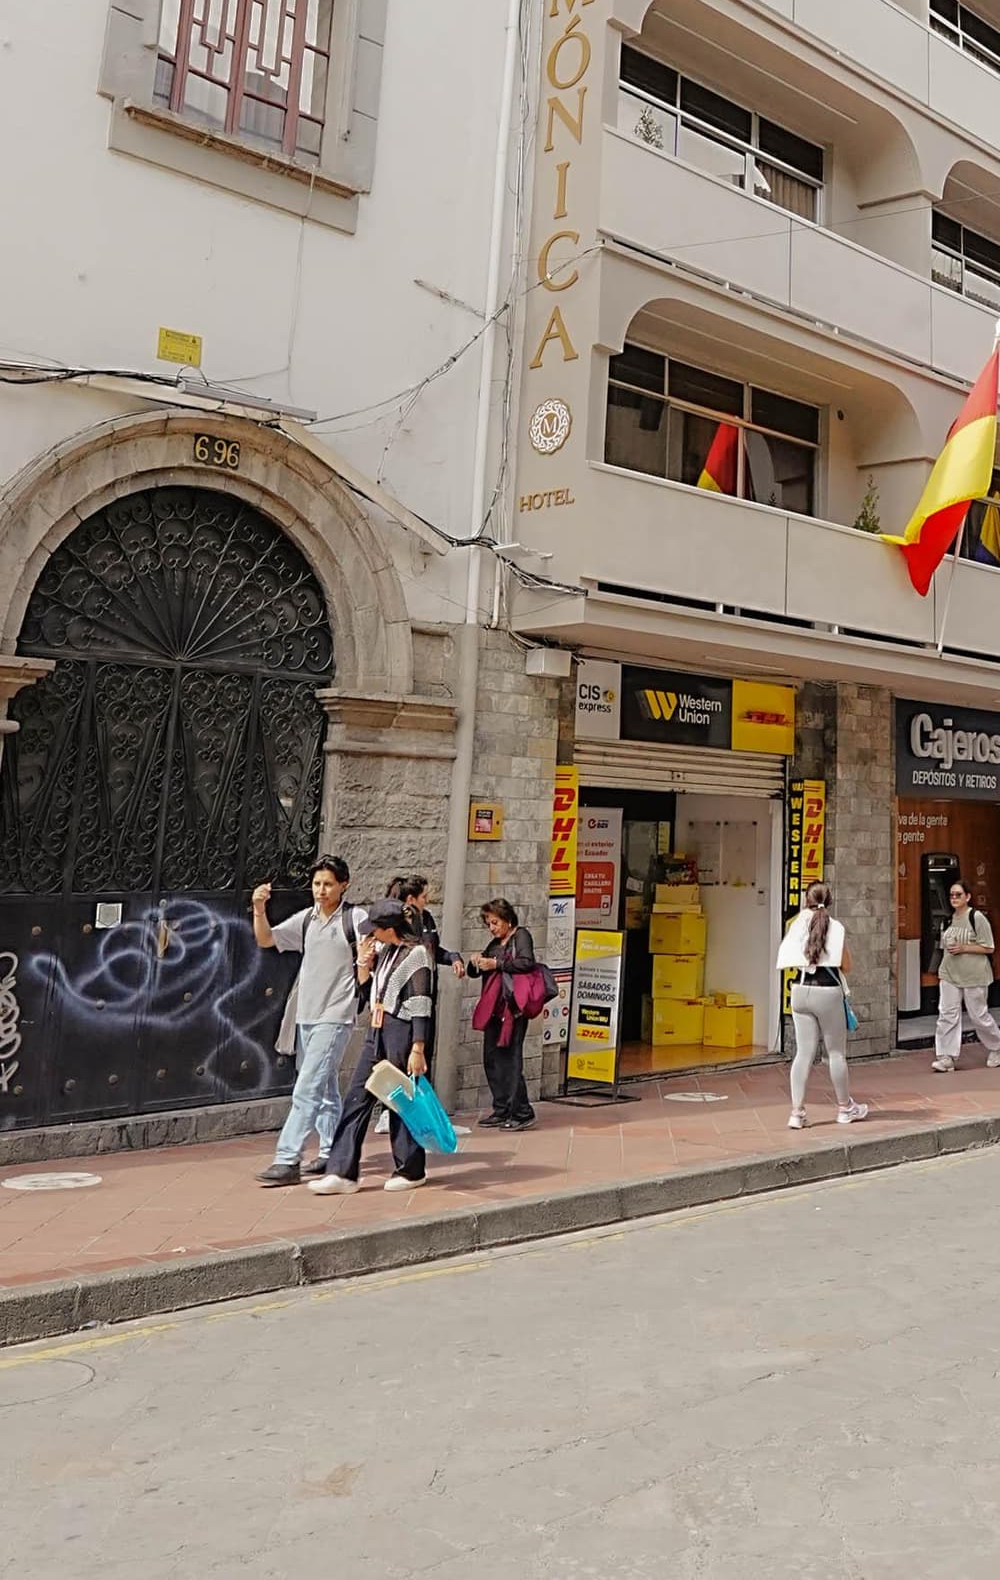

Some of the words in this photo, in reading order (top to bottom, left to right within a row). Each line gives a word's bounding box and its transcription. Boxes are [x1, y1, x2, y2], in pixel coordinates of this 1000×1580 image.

[195, 435, 240, 467] 696
[520, 489, 575, 512] HOTEL
[579, 684, 600, 700] CIS
[579, 702, 612, 714] express
[679, 693, 722, 712] Western
[679, 710, 710, 725] Union
[912, 770, 956, 787] DEPÓSITOS
[958, 774, 964, 787] Y
[965, 774, 997, 789] RETIROS
[908, 812, 918, 825] de
[919, 812, 926, 825] la
[926, 814, 948, 828] gente
[551, 788, 576, 871] DHL
[804, 798, 823, 869] DHL
[902, 831, 925, 844] gente
[789, 797, 803, 906] WESTERN
[577, 991, 616, 1002] DOMINGOS
[581, 1029, 605, 1039] DHL
